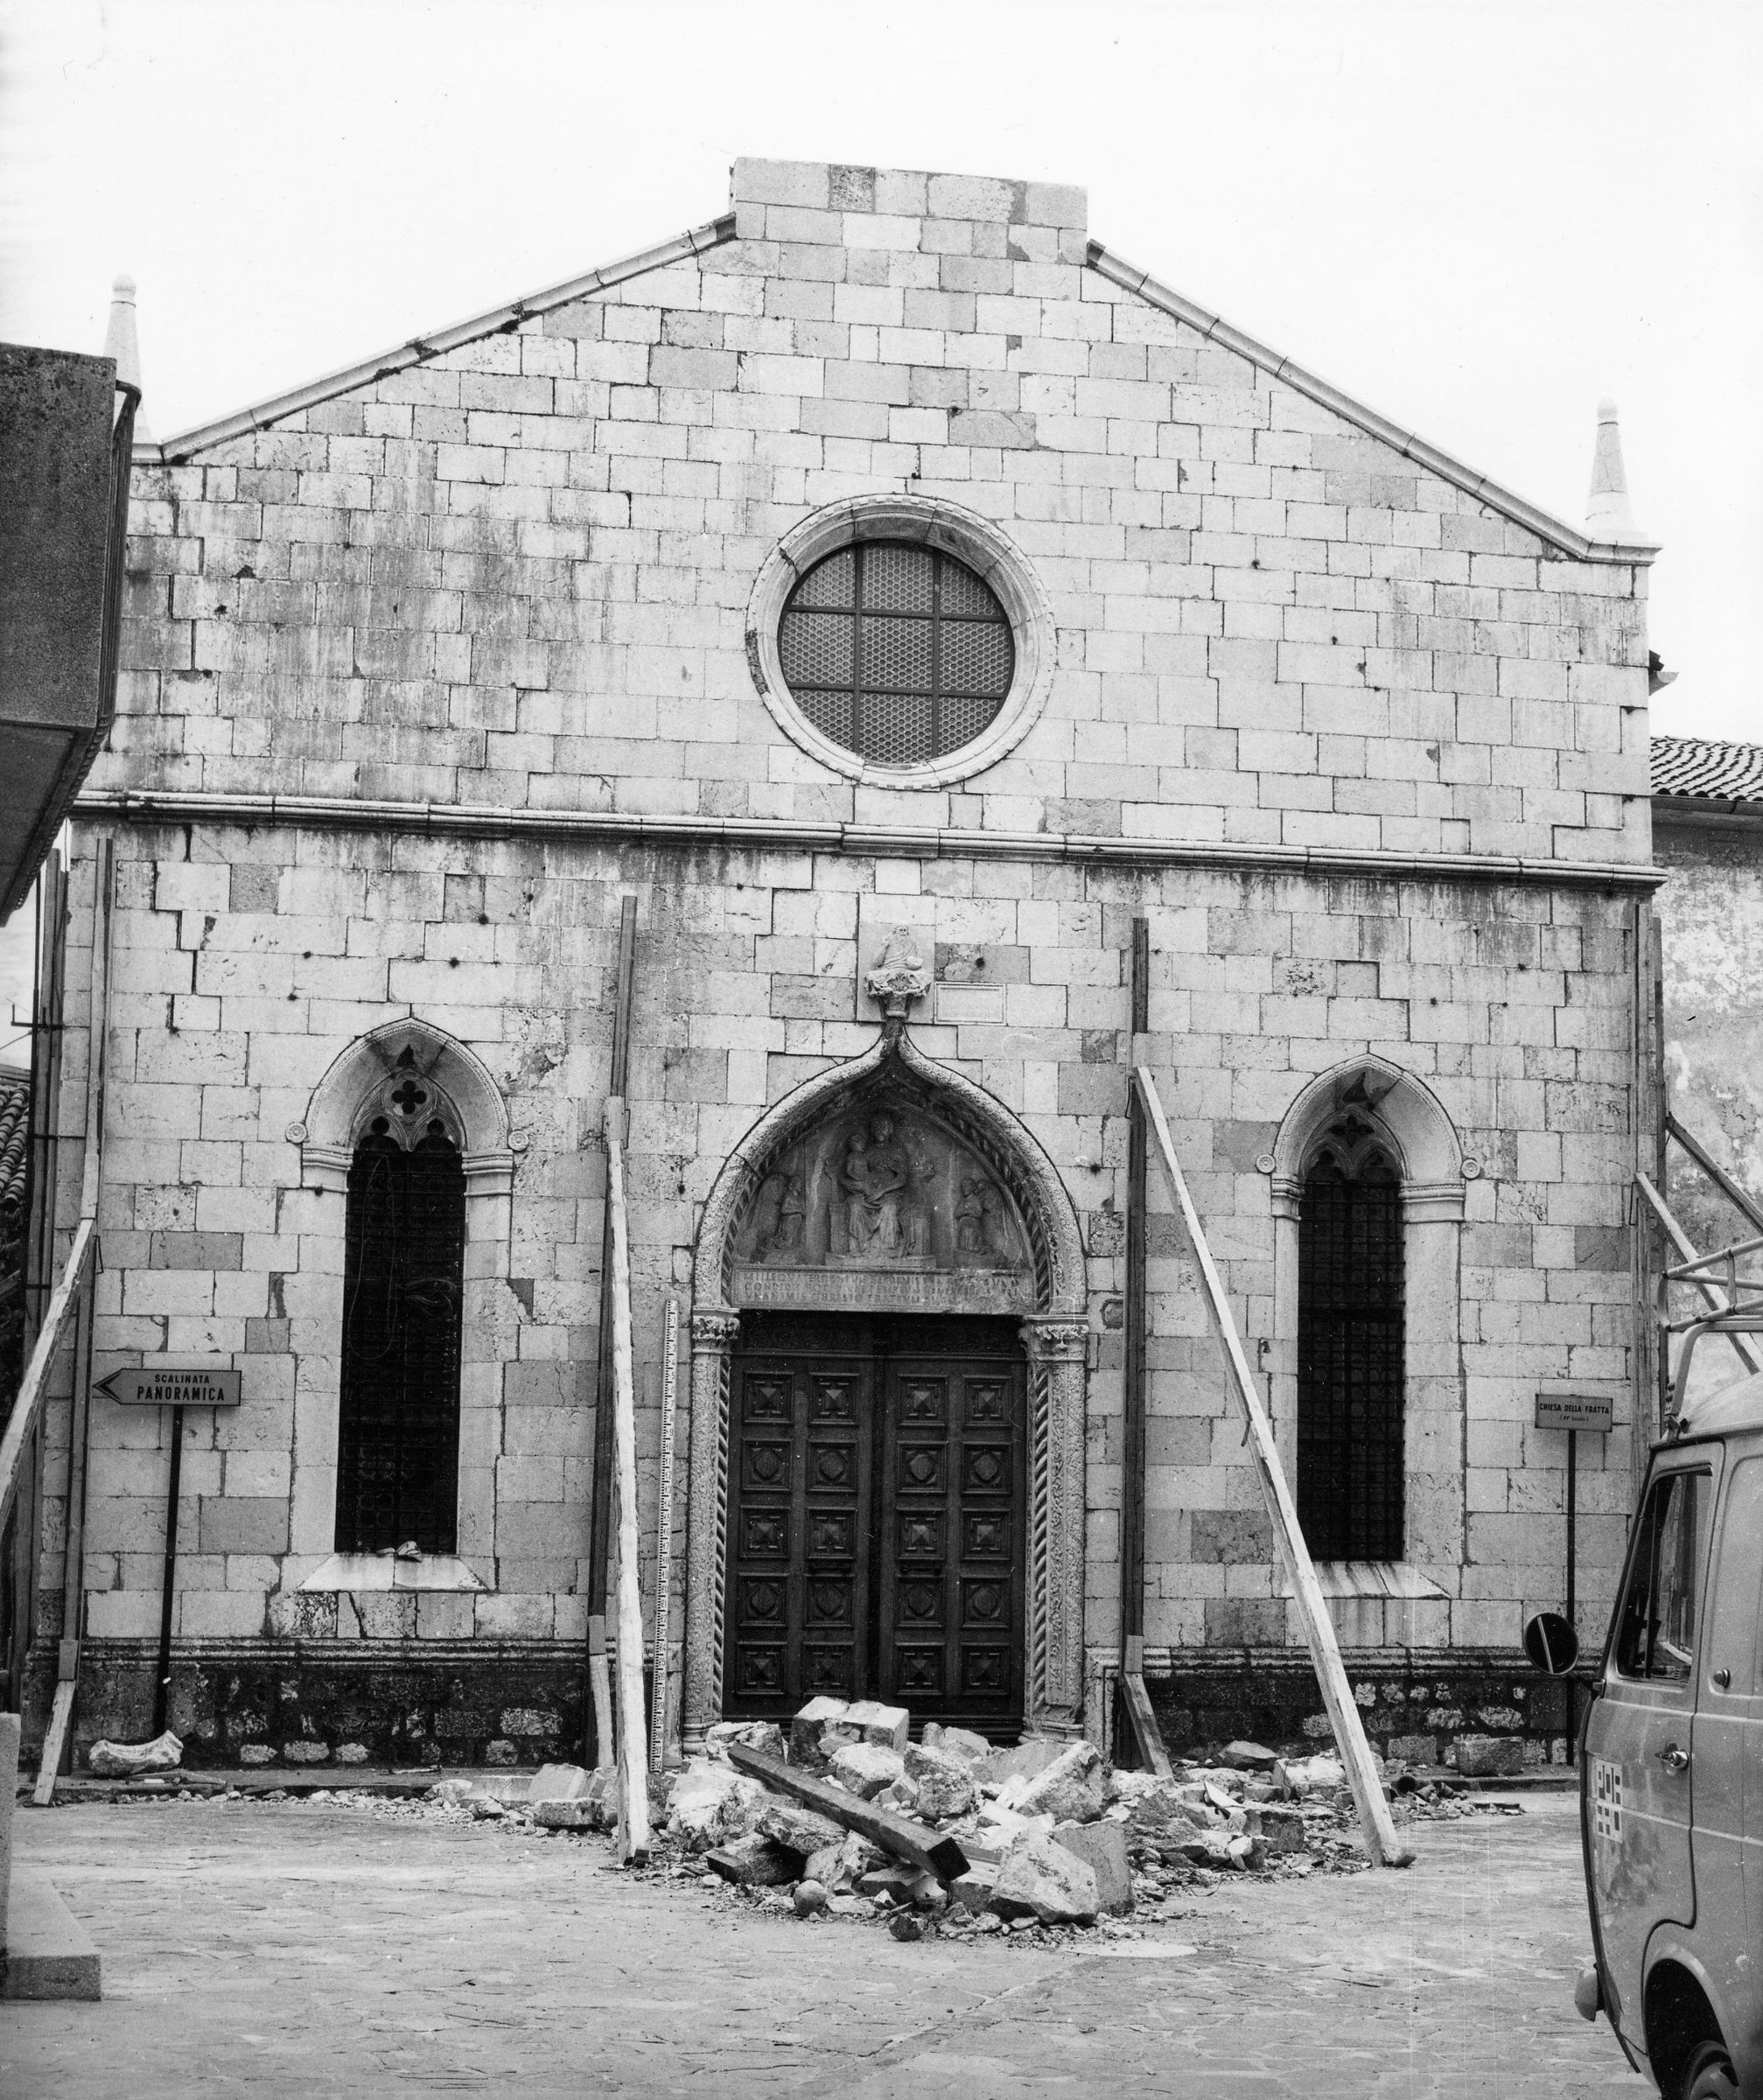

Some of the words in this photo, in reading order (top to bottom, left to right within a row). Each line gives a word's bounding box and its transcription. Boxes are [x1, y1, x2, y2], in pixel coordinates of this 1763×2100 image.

[154, 1374, 210, 1384] SCALINATA
[136, 1386, 225, 1401] PANORAMICA
[1539, 1403, 1562, 1411] CHIESA
